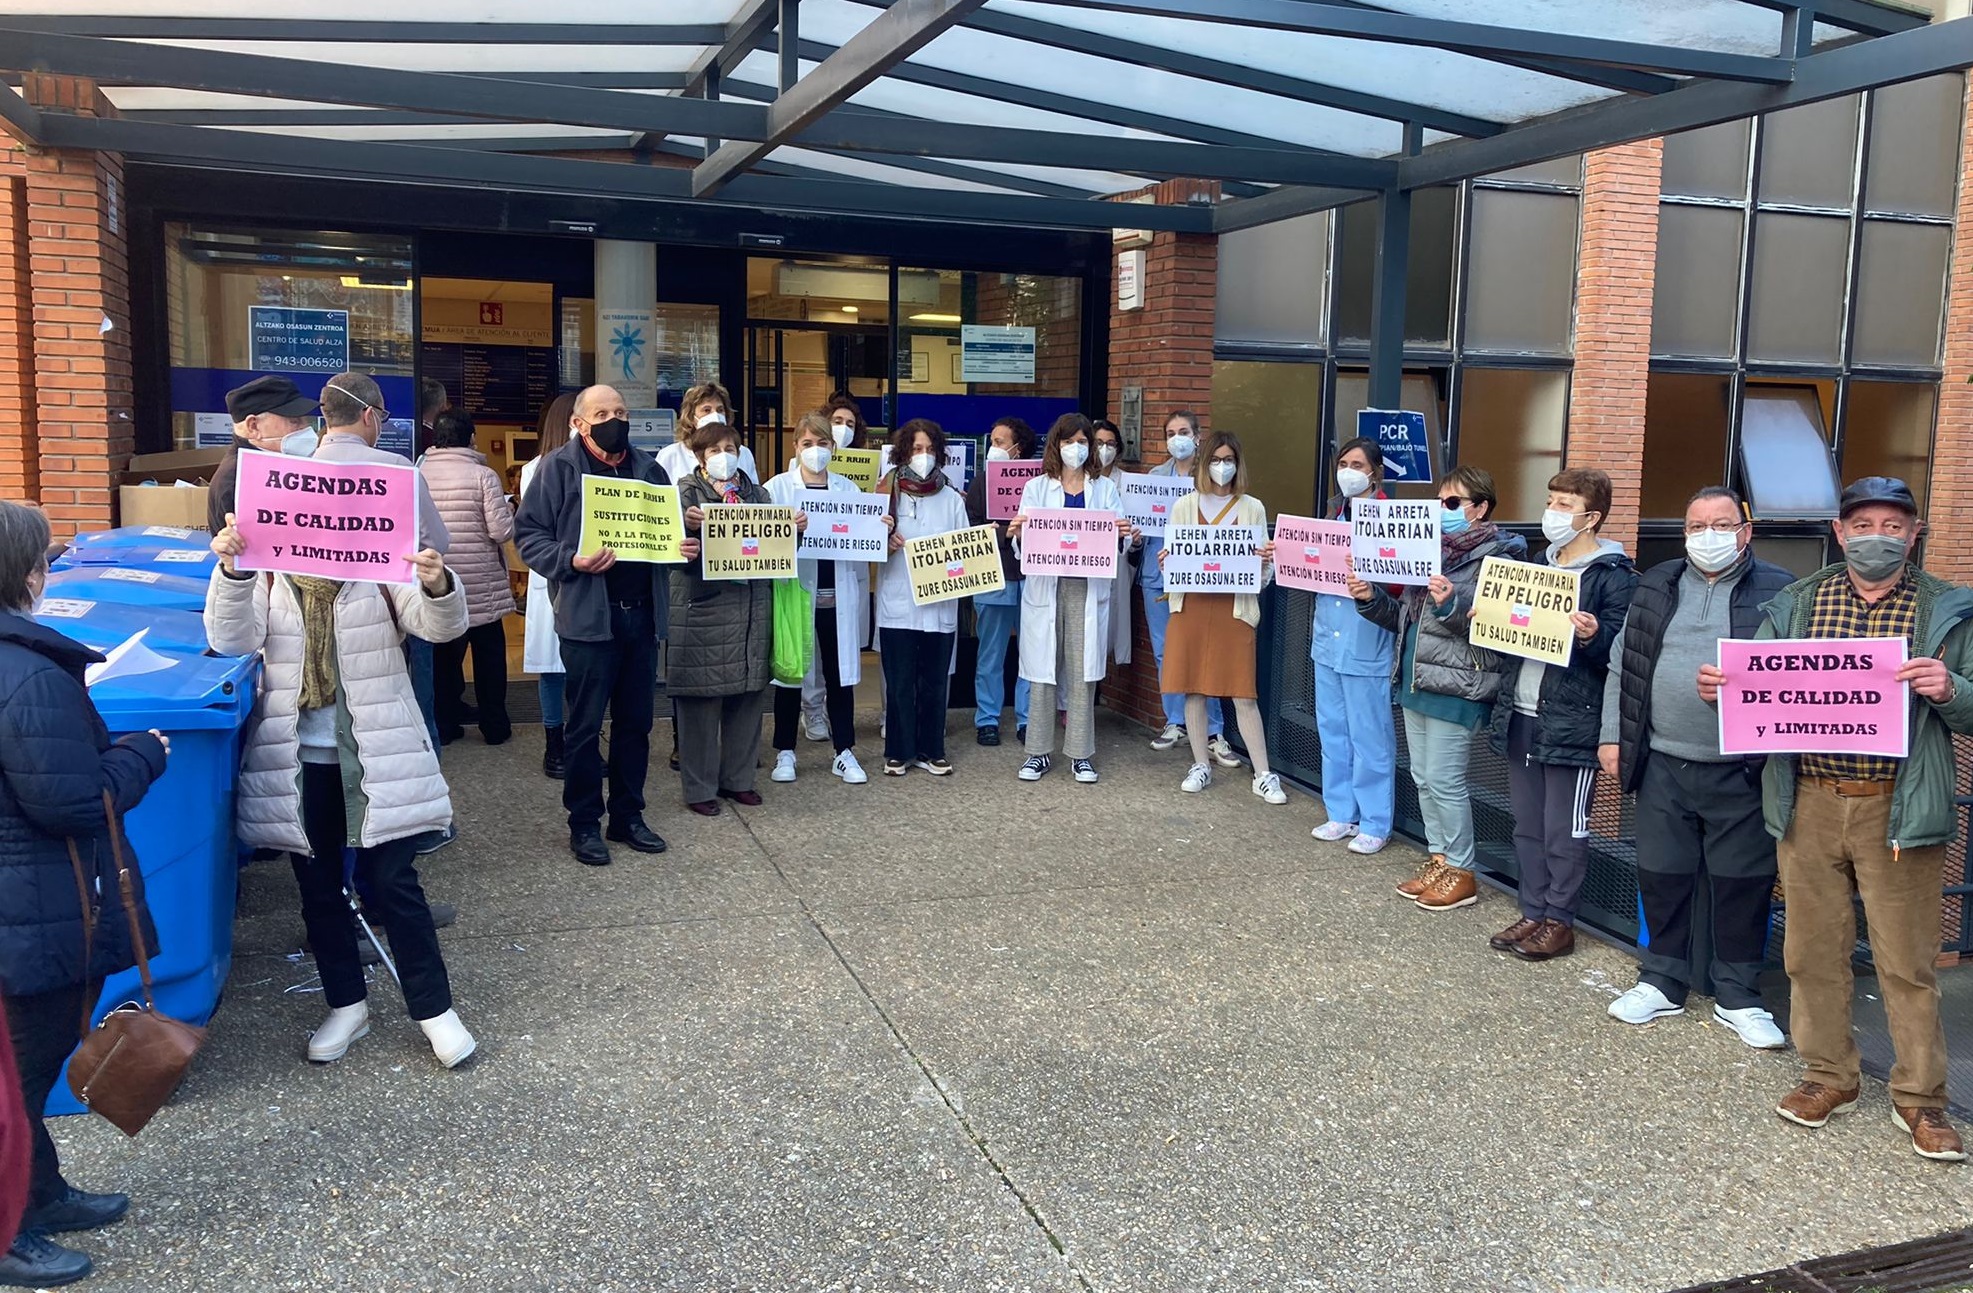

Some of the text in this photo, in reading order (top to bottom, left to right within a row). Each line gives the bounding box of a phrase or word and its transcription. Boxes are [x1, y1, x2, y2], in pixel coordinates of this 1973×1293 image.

[275, 356, 343, 368] 943-006520
[646, 422, 652, 432] 5
[1380, 424, 1408, 439] PCR
[1001, 468, 1042, 477] AGEND
[266, 470, 387, 495] AGENDAS
[1126, 484, 1157, 495] ATENCIÓN
[1160, 486, 1169, 496] SIN
[595, 487, 665, 503] PLAN DE RRHH
[709, 506, 791, 521] ATENCIÓN PRIMARIA
[801, 500, 883, 516] ATENCIÓN SIN TIEMPO
[1359, 504, 1430, 519] LEHEN ARRETA
[257, 509, 394, 532] DE CALIDAD
[594, 510, 670, 525] SUSTITUCIONES
[1029, 518, 1113, 532] ATENCIÓN SIN TIEMPO
[640, 532, 657, 541] FUGA
[709, 524, 792, 538] EN PELIGRO
[1176, 529, 1253, 540] LEHEN ARRETA
[1278, 527, 1351, 547] ATENCIÓN SIN TIEMPO
[1355, 521, 1434, 539] ITOLARRIAN
[602, 540, 668, 551] PROFESIONALES
[840, 539, 850, 549] DE
[853, 539, 881, 550] RIESGO
[914, 529, 988, 553] LEHEN ARRETA
[272, 545, 390, 564] y LIMITADAS
[912, 542, 994, 569] ITOLARRIAN
[1171, 543, 1256, 556] ITOLARRIAN
[709, 556, 791, 571] TU SALUD TAMBIÉN
[1027, 553, 1110, 567] ATENCIÓN DE RIESGO
[1354, 556, 1432, 577] ZURE OSASUNA ERE
[1170, 572, 1254, 585] ZURE OSASUNA ERE
[1280, 565, 1347, 585] ATENCIÓN DE RIESG
[1487, 563, 1574, 592] ATENCIÓN PRIMARIA
[918, 571, 998, 598] ZURE OSASUNA ERE
[1482, 581, 1573, 613] EN PELIGRO
[1476, 622, 1564, 654] TU SALUD TAMBIÉN
[1747, 654, 1873, 671] AGENDAS
[1742, 690, 1881, 705] DE CALIDAD
[1756, 723, 1878, 737] y LIMITADAS
